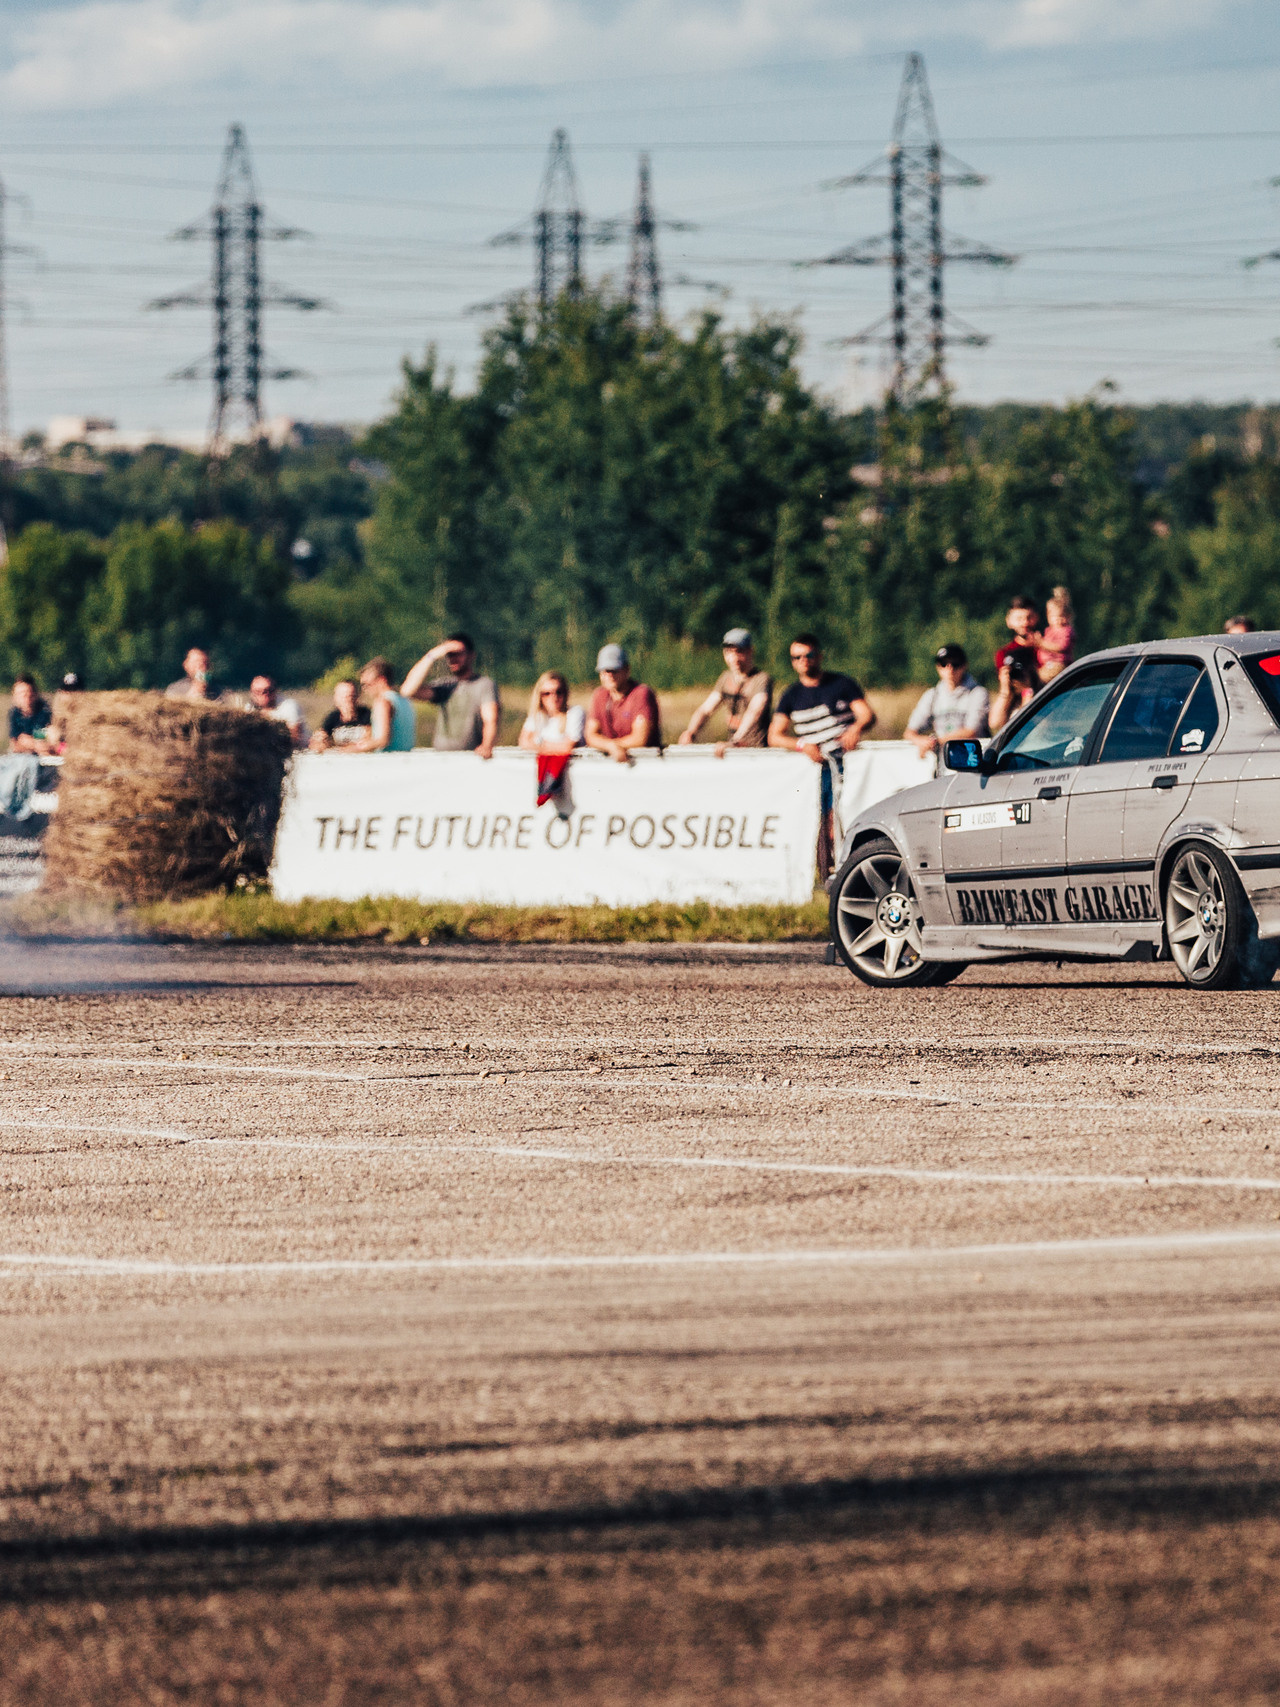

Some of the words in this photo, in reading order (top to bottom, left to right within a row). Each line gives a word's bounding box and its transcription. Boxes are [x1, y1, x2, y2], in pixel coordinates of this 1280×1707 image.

[314, 815, 383, 850] THE
[391, 815, 535, 850] FUTURE
[545, 815, 596, 850] OF
[605, 815, 781, 850] POSSIBLE
[956, 887, 1061, 923] BMWEAST
[1064, 884, 1160, 921] GARAGE
